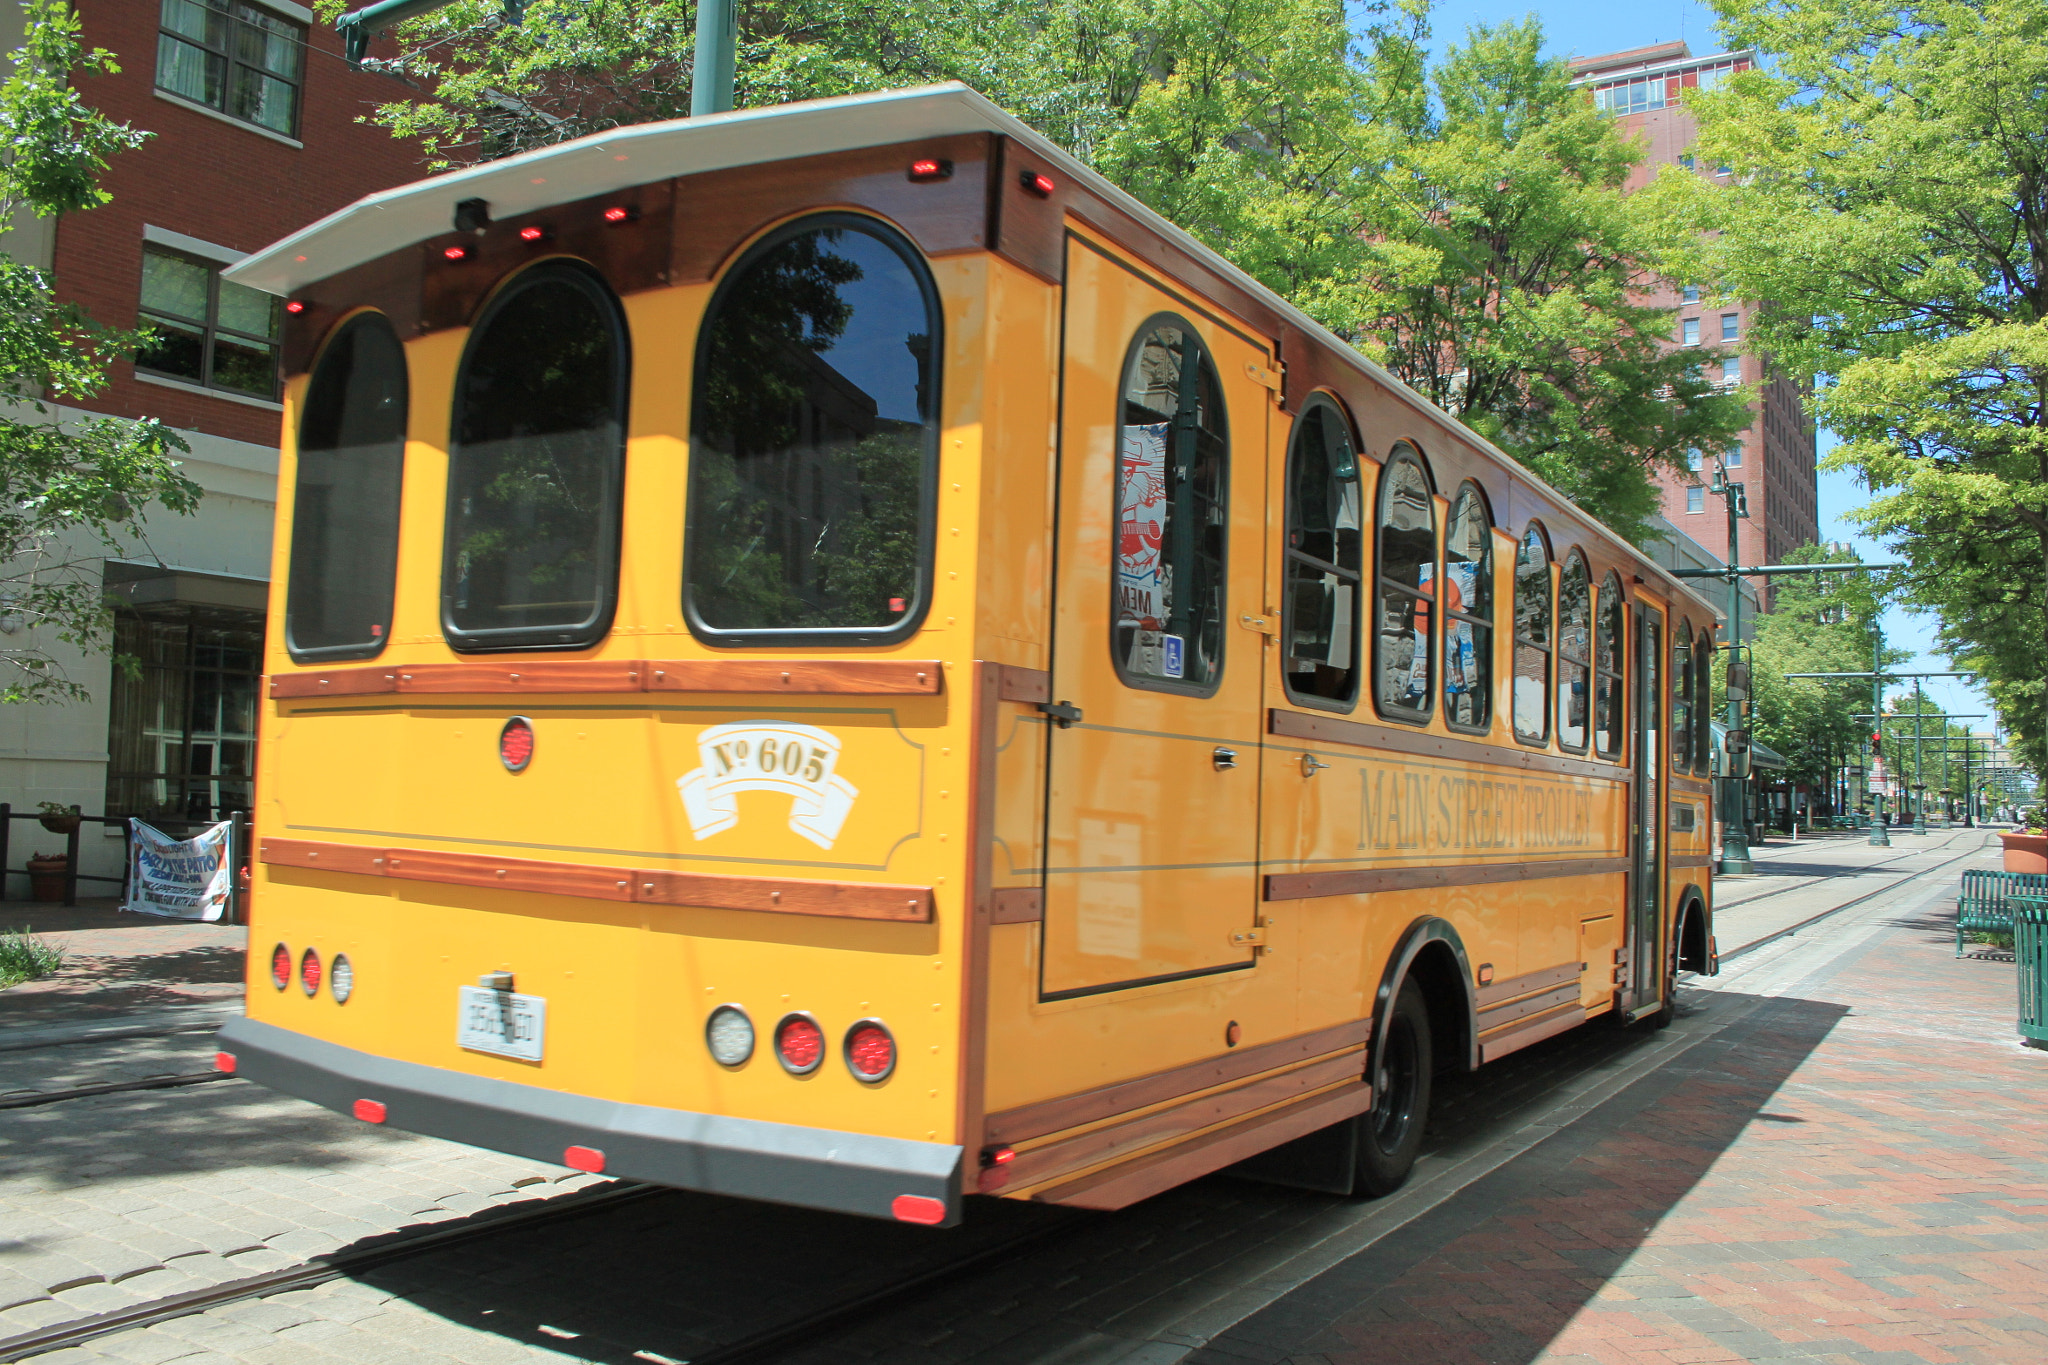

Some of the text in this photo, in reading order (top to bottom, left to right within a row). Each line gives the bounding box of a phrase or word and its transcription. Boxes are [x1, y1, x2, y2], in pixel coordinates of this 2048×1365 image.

[758, 737, 828, 783] 605
[1358, 768, 1594, 850] MAIN STREET TROLLEY
[186, 854, 217, 873] PATIO
